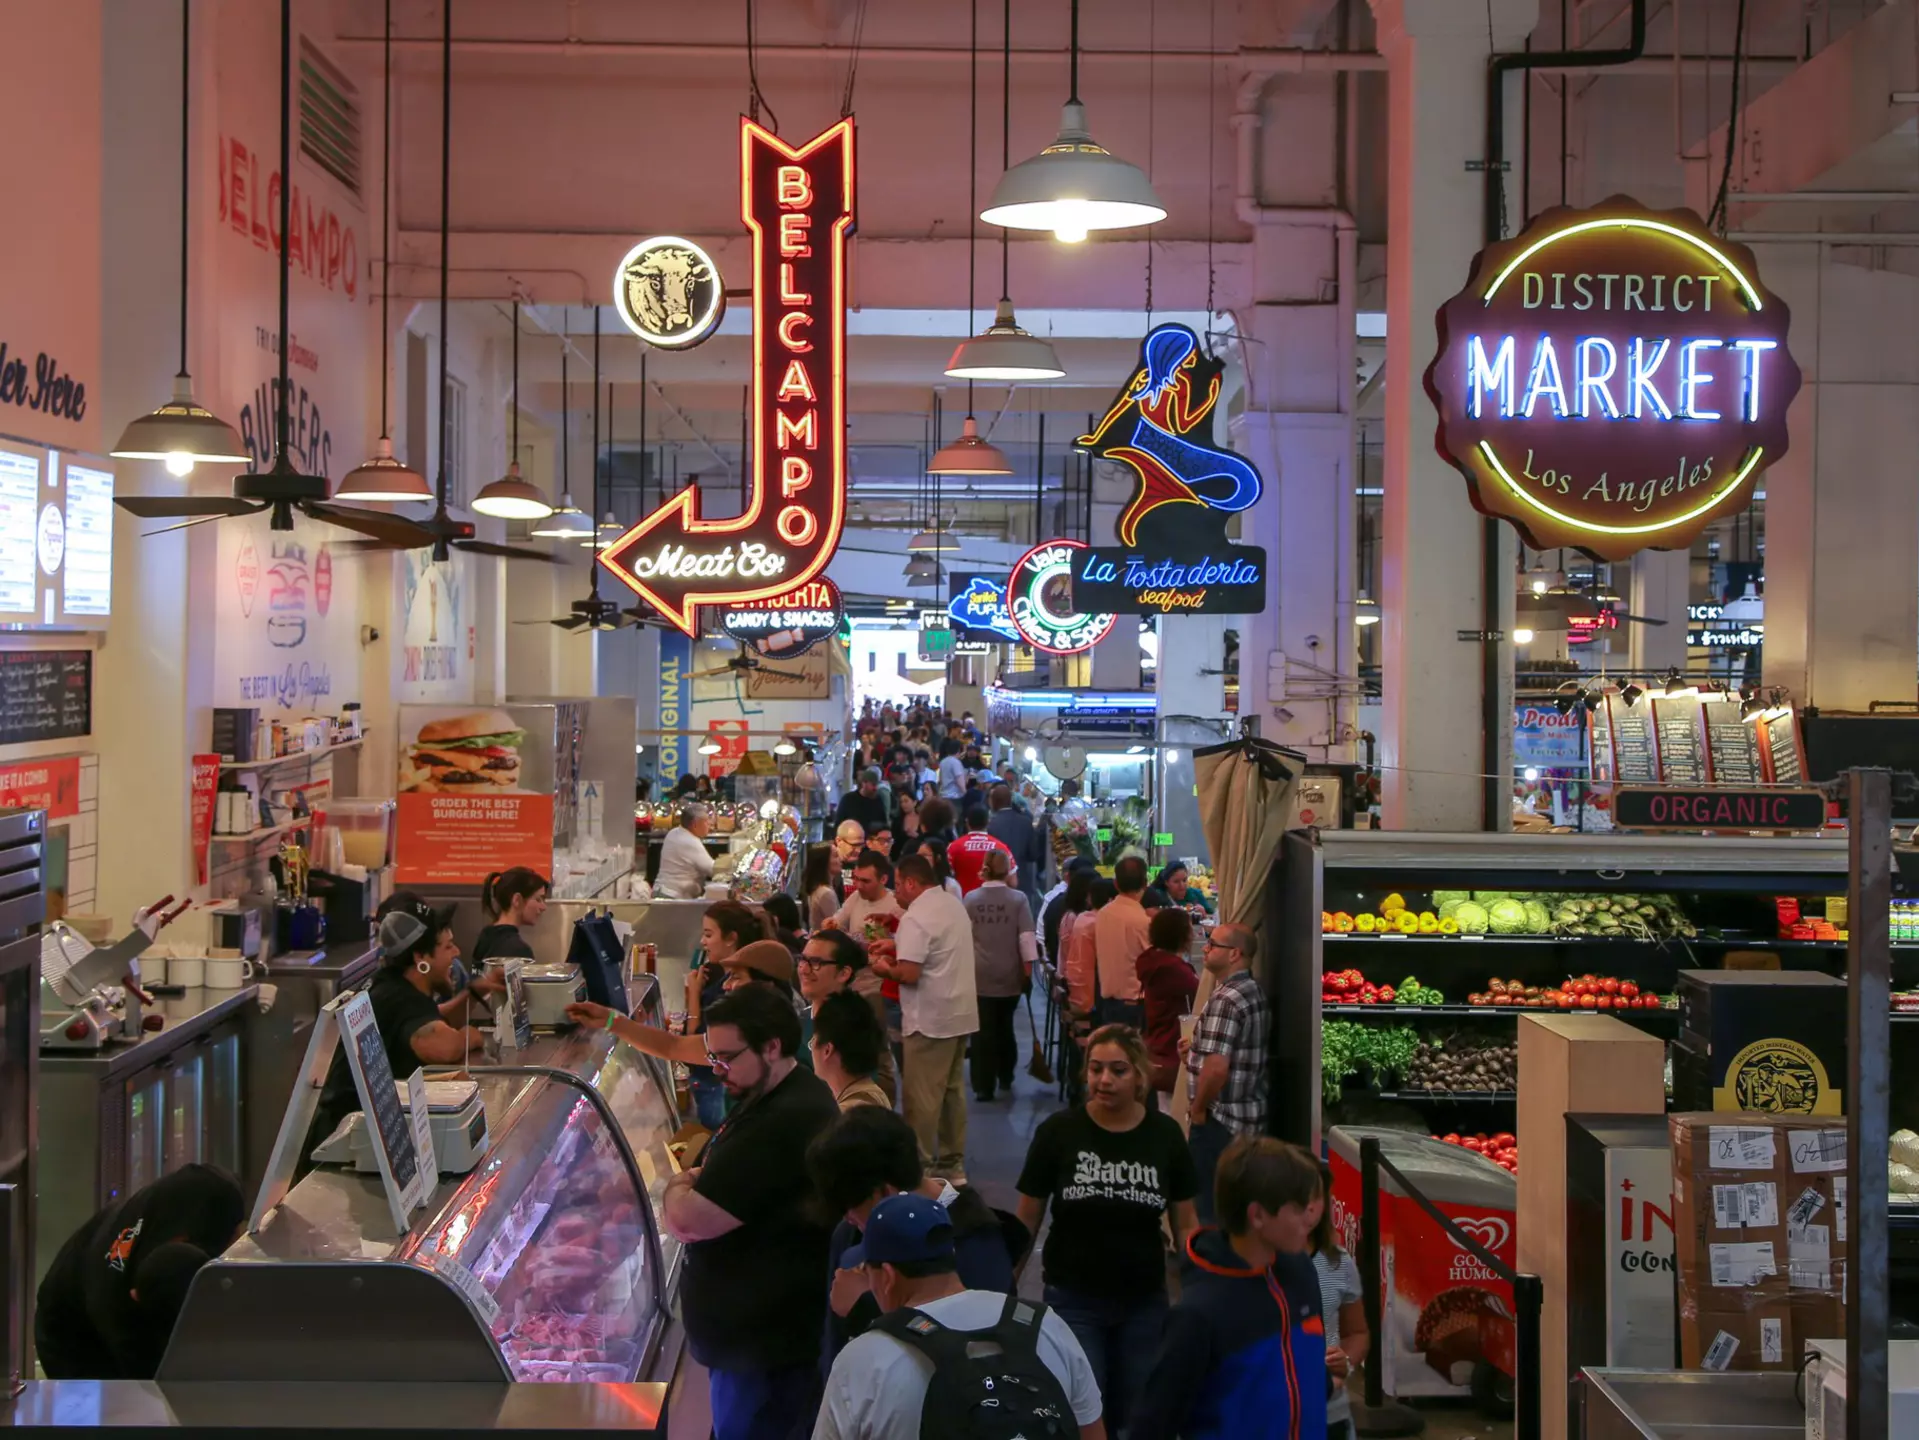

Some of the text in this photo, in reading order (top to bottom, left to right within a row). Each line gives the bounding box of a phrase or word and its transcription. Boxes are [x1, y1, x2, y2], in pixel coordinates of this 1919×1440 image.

[1523, 272, 1719, 311] DISTRICT
[775, 165, 818, 546] BELCAMPO
[29, 352, 86, 422] Here
[1467, 333, 1777, 423] MARKET
[1523, 449, 1714, 512] Los Angeles
[634, 543, 734, 578] Meat
[1081, 554, 1117, 582] La
[1138, 588, 1205, 612] seafood
[725, 610, 835, 628] CANDY & SNACKS
[1054, 630, 1072, 649] &
[1070, 612, 1113, 648] Spic
[431, 798, 521, 809] ORDER THE BEST
[433, 809, 519, 820] BURGERS HERE!
[1650, 795, 1789, 824] ORGANIC
[1766, 1042, 1795, 1051] MINERAL
[1796, 1047, 1816, 1064] WATER
[1074, 1150, 1160, 1189] Bacon
[1449, 1267, 1503, 1280] HUMO
